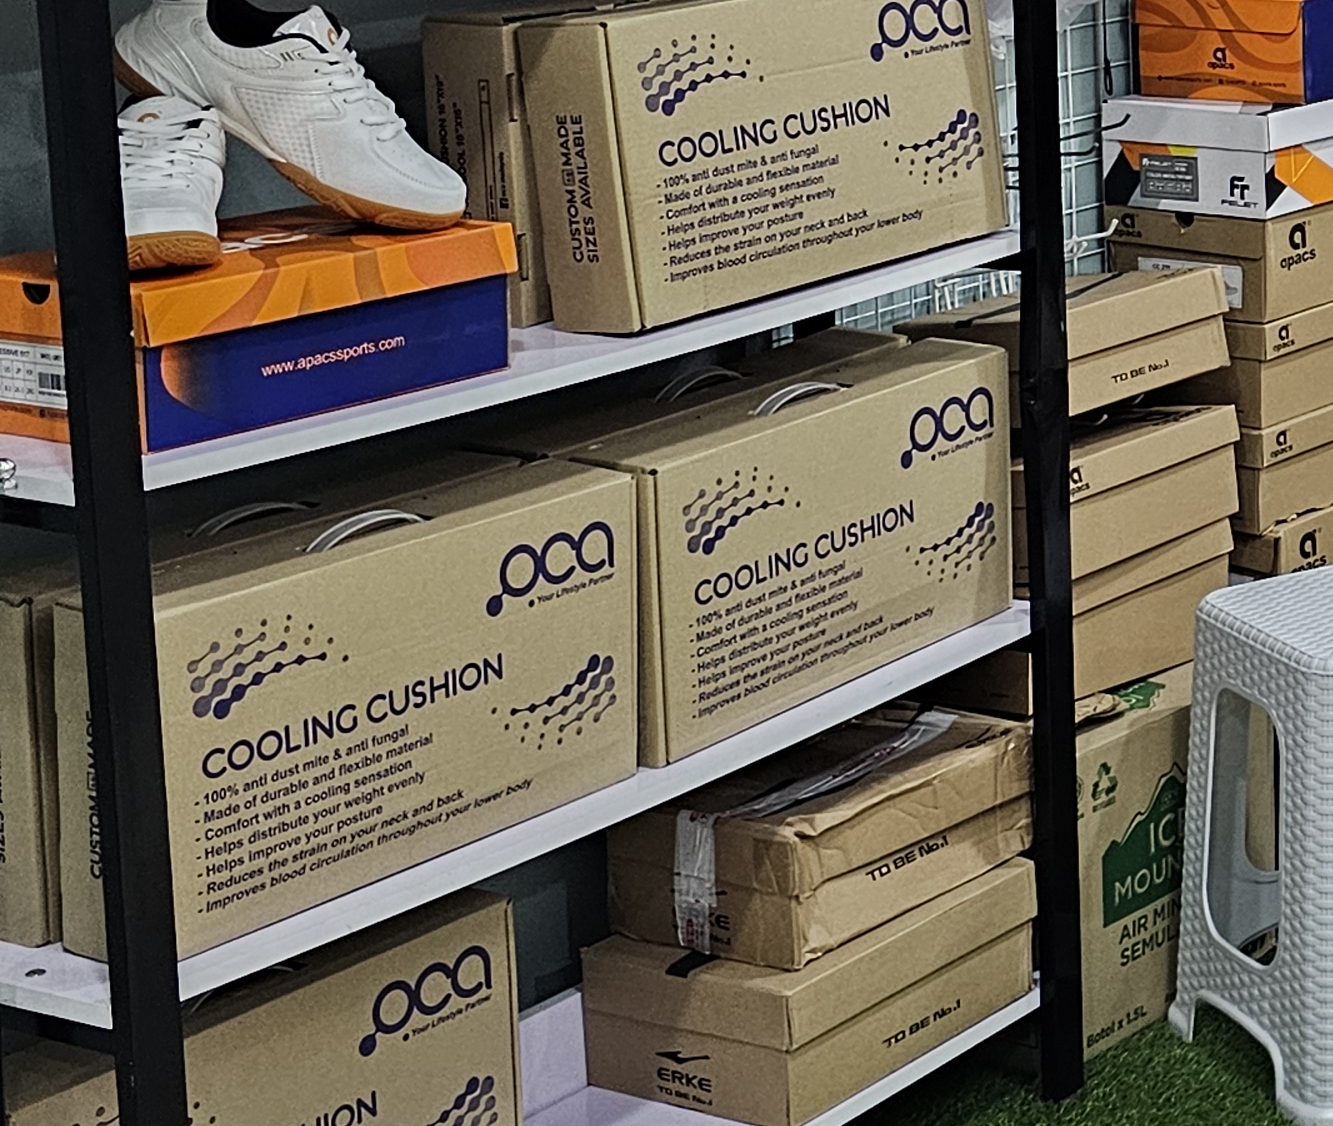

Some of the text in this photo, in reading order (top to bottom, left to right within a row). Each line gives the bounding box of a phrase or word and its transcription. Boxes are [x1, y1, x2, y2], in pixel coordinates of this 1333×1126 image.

[658, 93, 891, 168] COOLING CUSHION
[555, 114, 585, 264] CUSTOM MADE
[569, 113, 600, 264] SIZES AVAILABLE
[1279, 248, 1317, 271] apacs
[260, 332, 406, 378] www.apacssports.com
[1272, 336, 1296, 353] apacs
[1269, 439, 1293, 459] apacs
[694, 499, 915, 606] COOLING CUSHION
[201, 652, 503, 779] COOLING CUSHION
[203, 782, 240, 805] 100%
[242, 772, 268, 793] anti
[270, 763, 301, 783] dust
[302, 755, 330, 773] mite
[345, 737, 369, 757] anti
[371, 723, 409, 748] fungal
[203, 732, 433, 824] Made of durable and flexible material
[204, 812, 261, 842] Comfort
[261, 802, 291, 822] with
[304, 782, 351, 807] cooling
[353, 759, 413, 789] sensation
[204, 771, 426, 861] Helps distribute your weight evenly
[205, 805, 383, 878] Helps improve your posture
[206, 789, 465, 896] Reduces the strain on your neck and back
[865, 835, 950, 883] TO BE No.1
[1114, 856, 1181, 907] MOUN
[1119, 897, 1180, 945] AIR MIN
[1119, 924, 1180, 968] SEMUL
[882, 998, 962, 1048] TO BE No.1
[1086, 1019, 1114, 1049] Botol
[657, 1067, 713, 1093] ERKE
